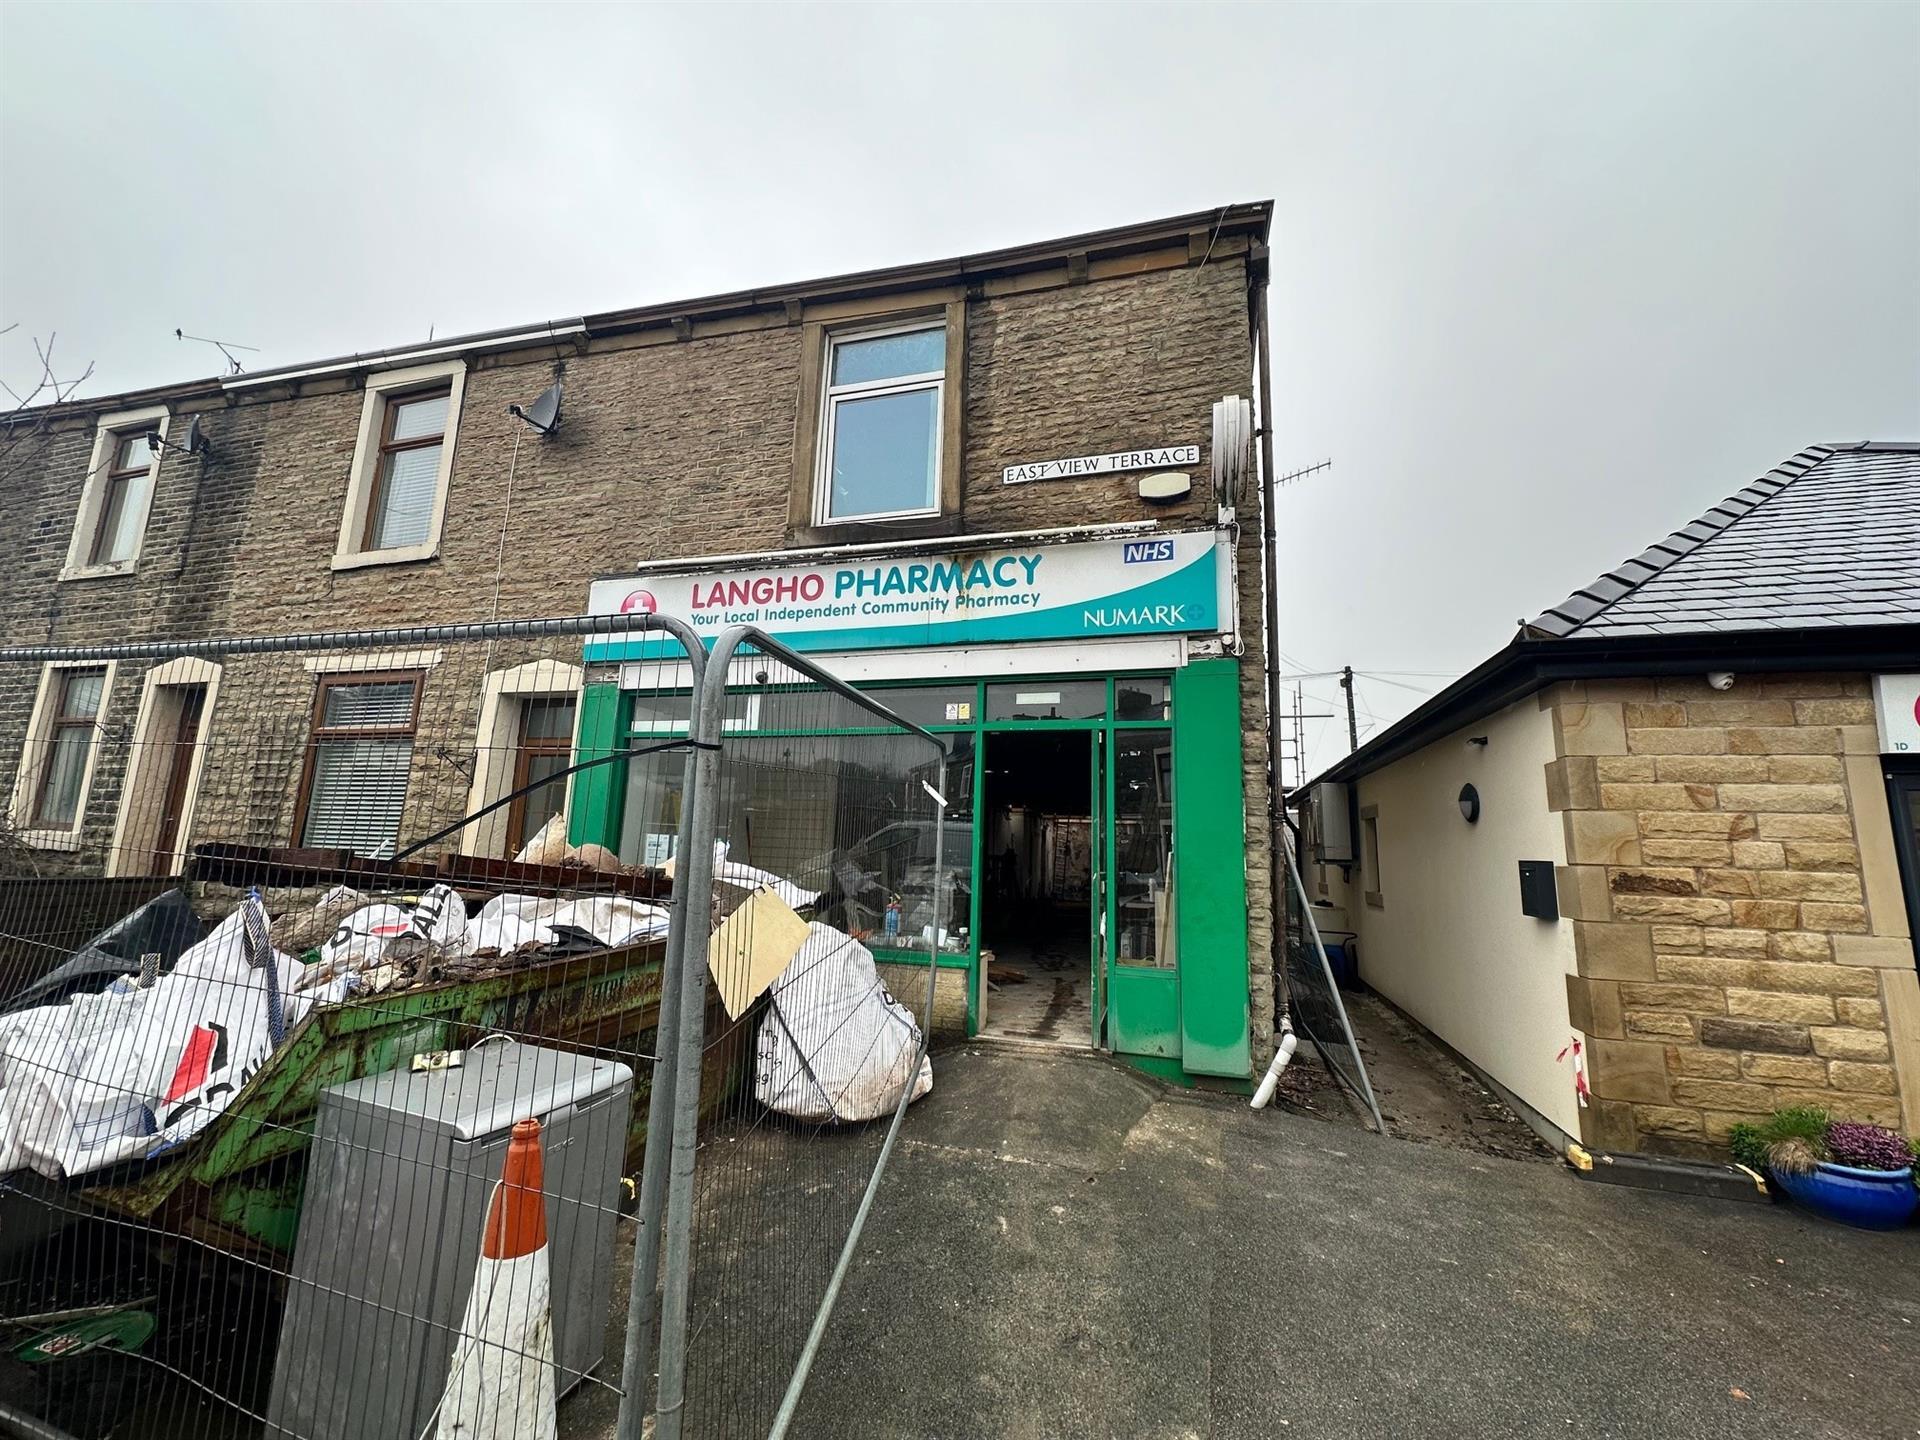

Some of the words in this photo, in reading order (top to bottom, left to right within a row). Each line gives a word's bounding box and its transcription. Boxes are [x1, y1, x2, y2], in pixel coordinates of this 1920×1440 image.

[1006, 464, 1048, 482] EAST
[1057, 458, 1100, 475] VIEW
[1109, 448, 1196, 470] TERRACE
[1126, 542, 1171, 562] NHS
[691, 573, 825, 609] LANGHO
[834, 553, 1043, 600] PHARMACY
[691, 613, 719, 626] Your
[724, 609, 759, 624] Local
[764, 603, 857, 623] Independent
[861, 596, 949, 614] Community
[955, 592, 1041, 610] Pharmacy
[1083, 603, 1186, 628] NUMARK
[1894, 742, 1909, 751] 1D
